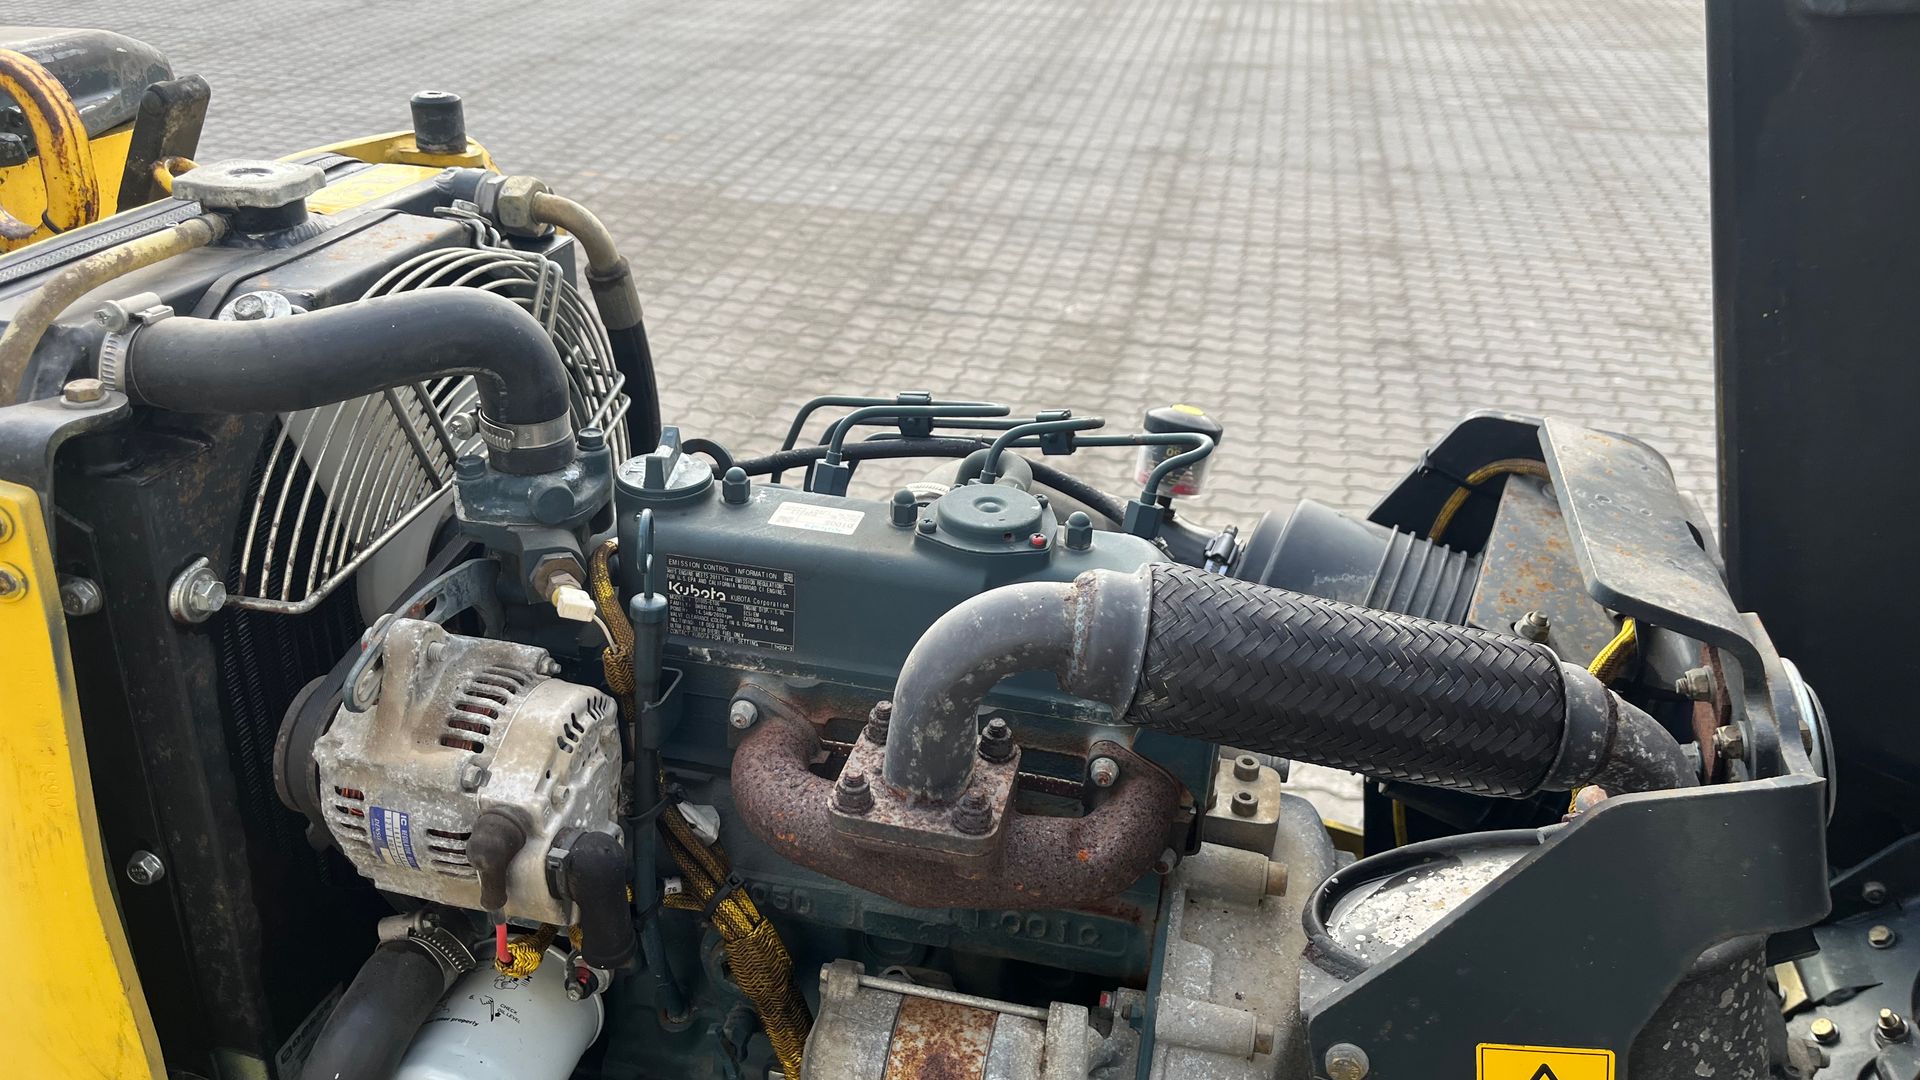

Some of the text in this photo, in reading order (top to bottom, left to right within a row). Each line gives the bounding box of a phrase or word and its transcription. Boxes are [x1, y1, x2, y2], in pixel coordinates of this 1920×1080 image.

[669, 558, 778, 580] EMISSION CONTROL INFORMATION
[668, 581, 726, 601] Kubota
[730, 594, 751, 603] KUBOTA
[500, 1003, 518, 1014] CHECK
[451, 1017, 479, 1026] properly
